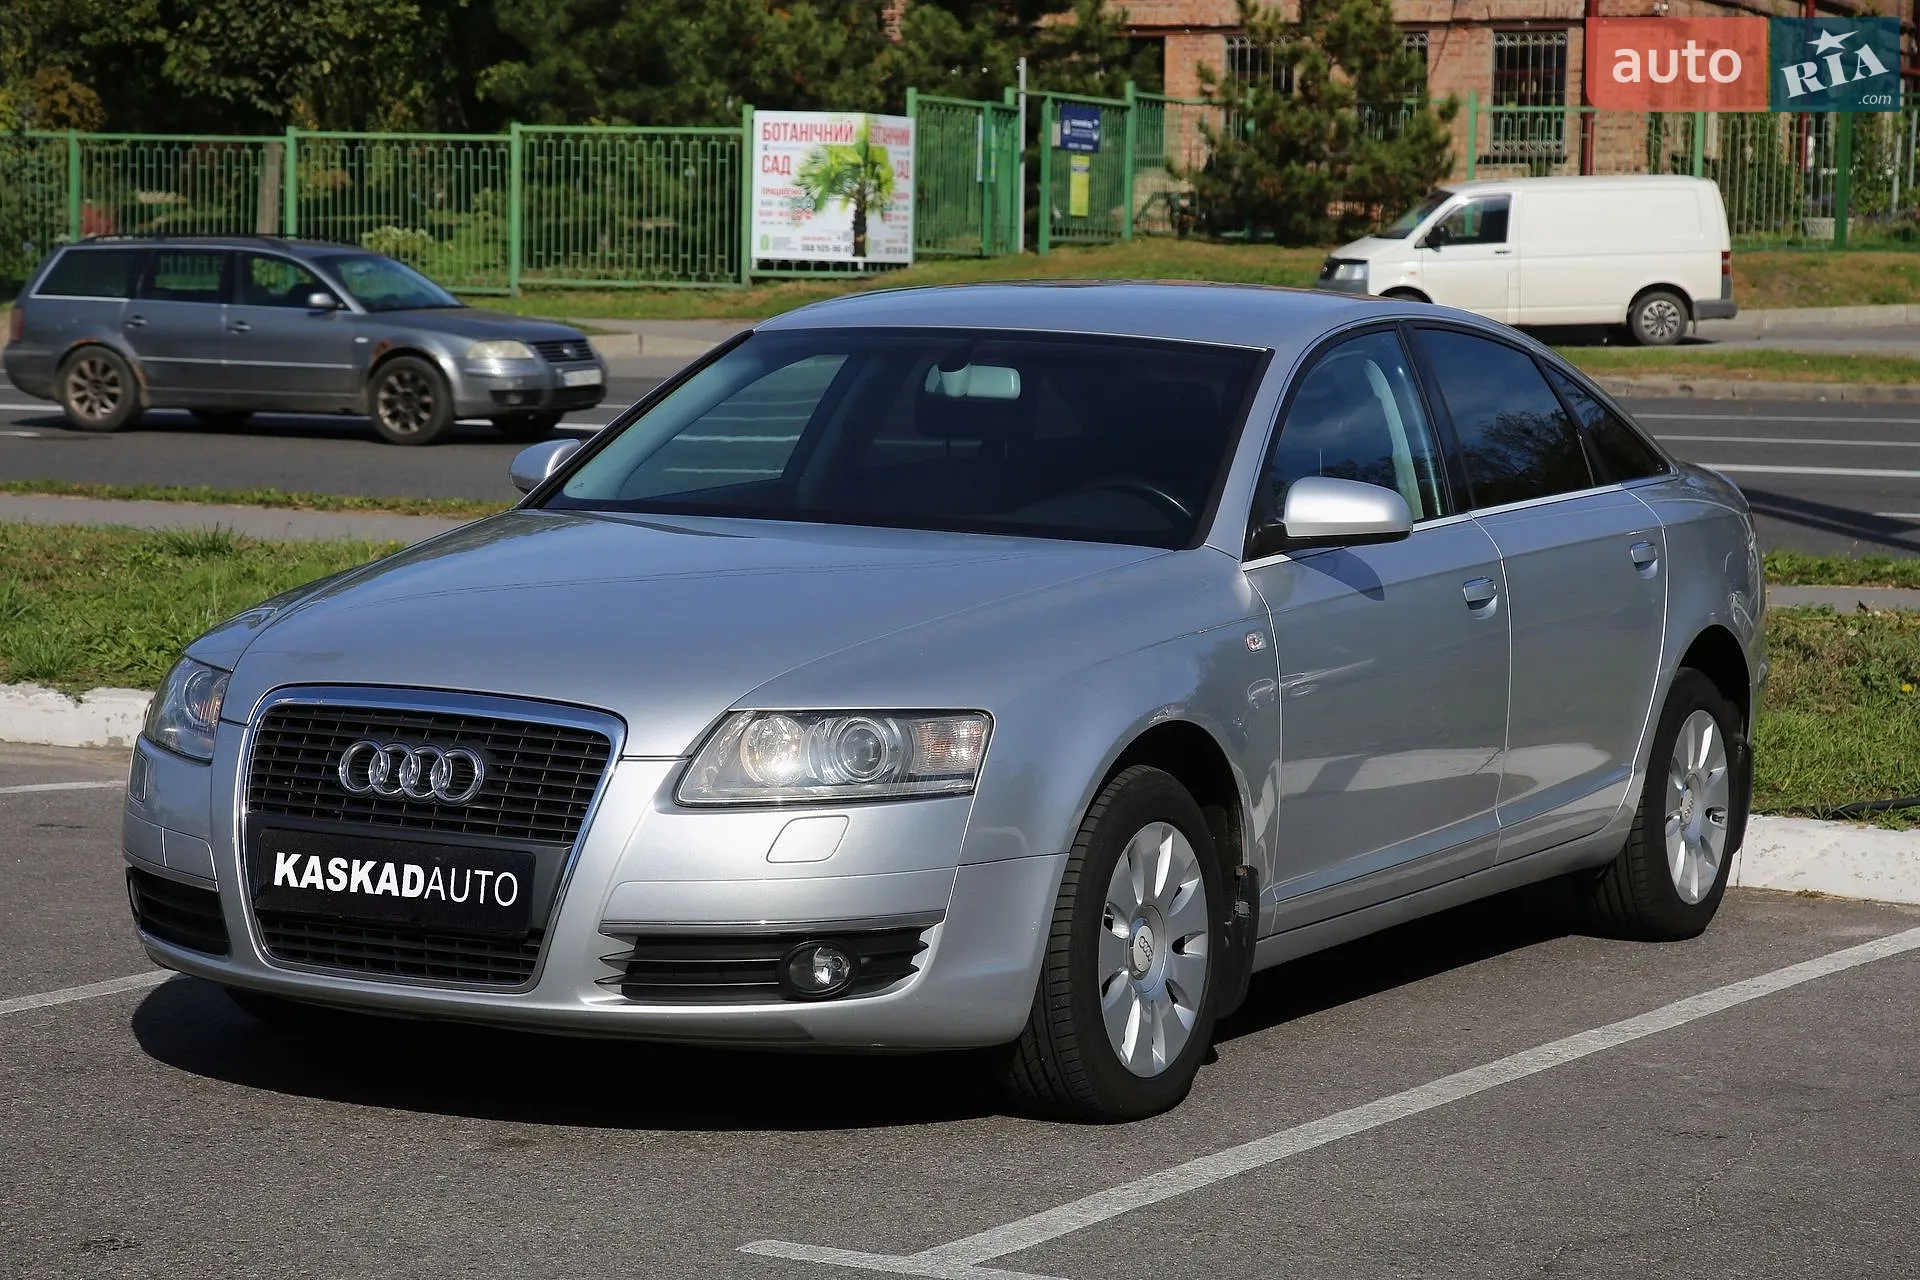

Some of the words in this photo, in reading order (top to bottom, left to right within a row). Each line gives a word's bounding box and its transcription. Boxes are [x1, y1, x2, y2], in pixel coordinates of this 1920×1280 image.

[762, 120, 854, 143] БОТАНІЧНИЙ
[761, 154, 791, 176] САД
[273, 852, 518, 907] KASKADAUTO
